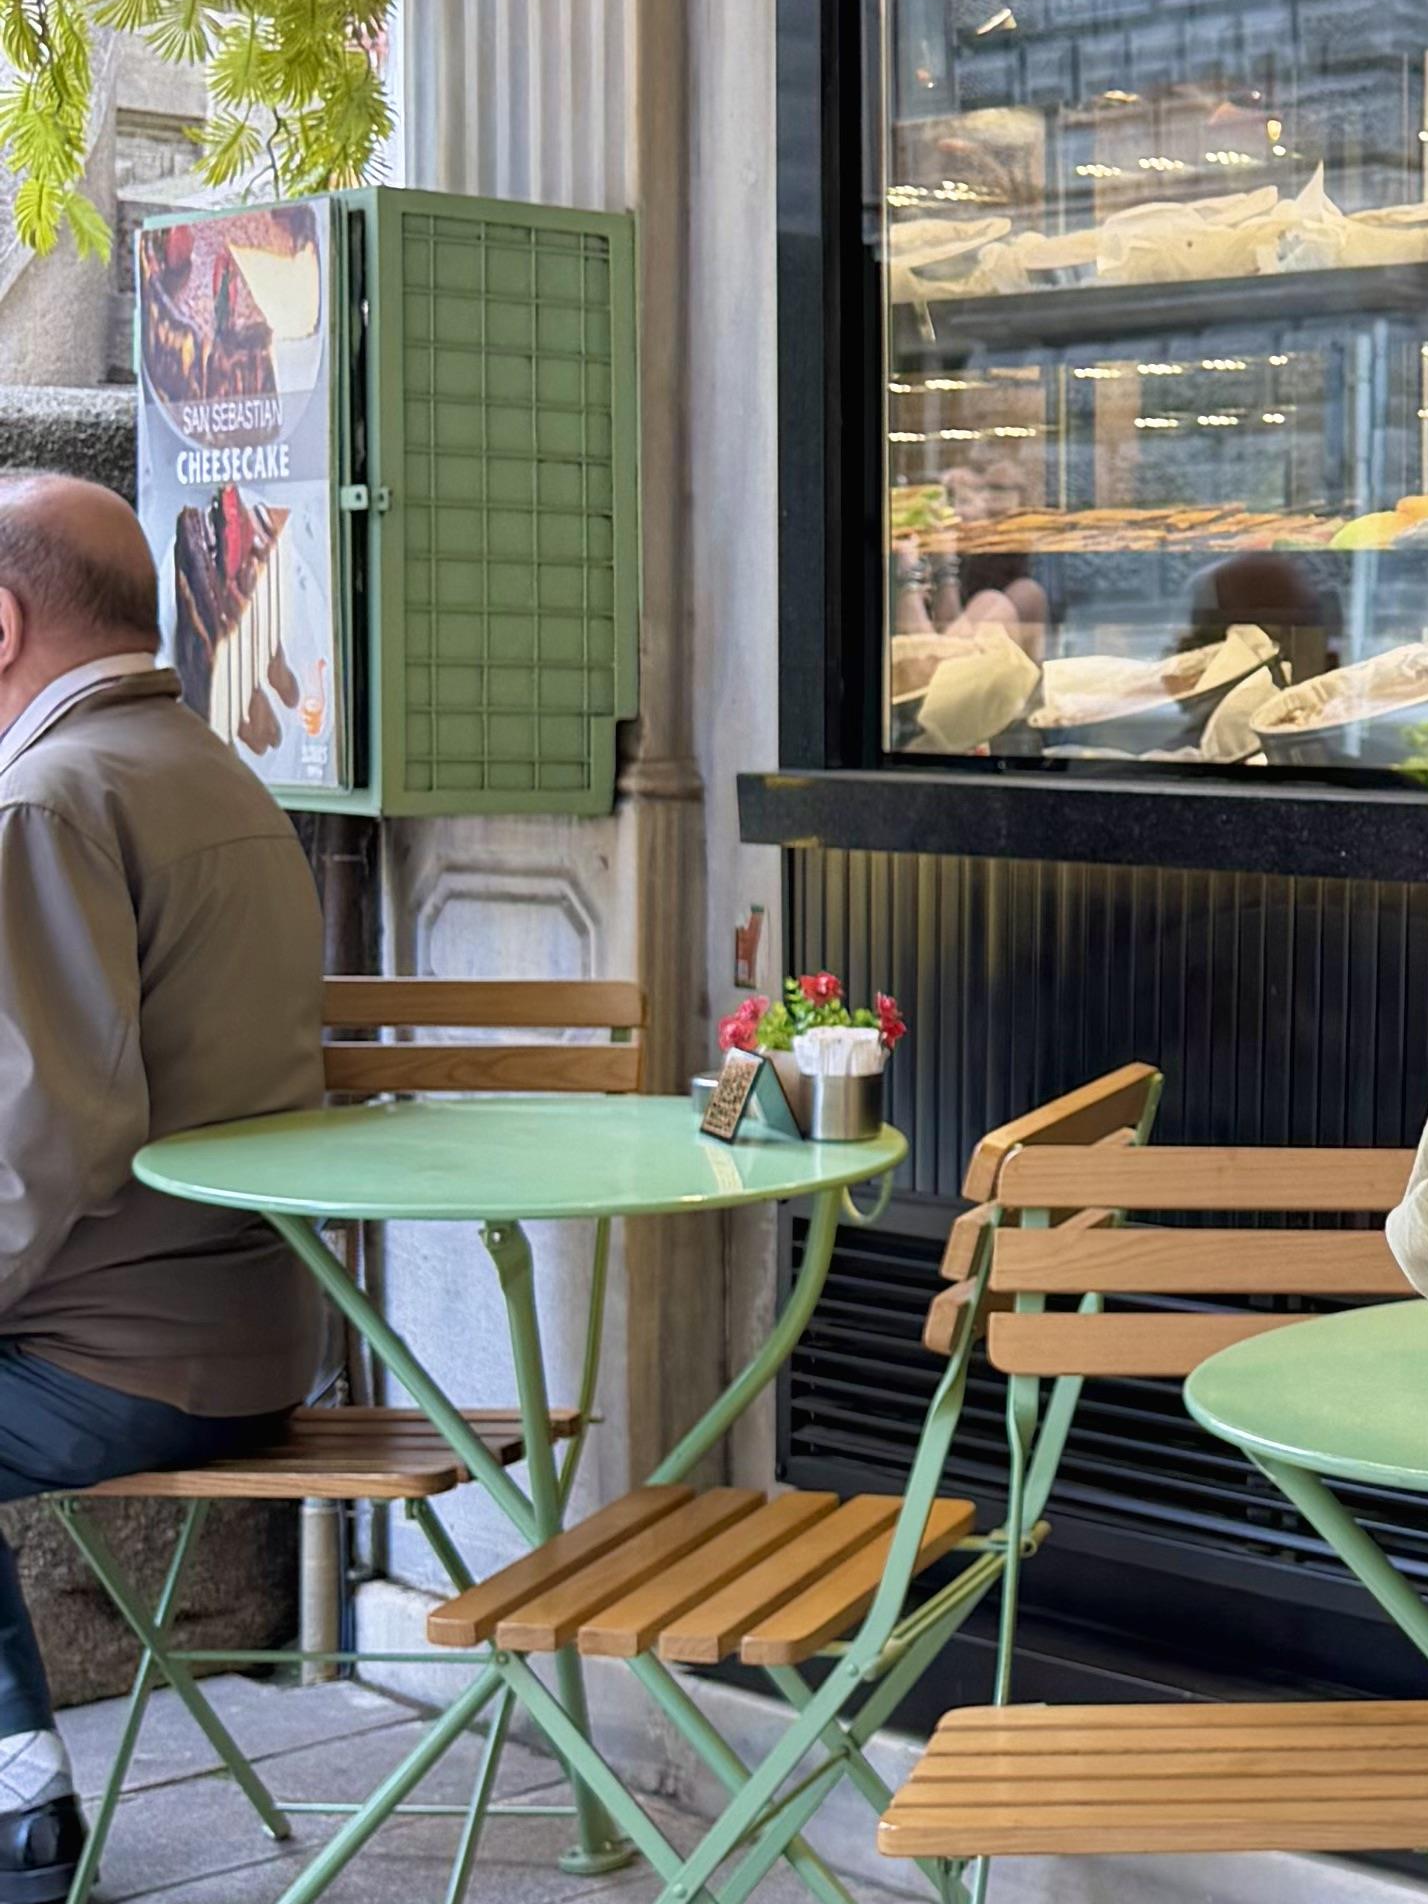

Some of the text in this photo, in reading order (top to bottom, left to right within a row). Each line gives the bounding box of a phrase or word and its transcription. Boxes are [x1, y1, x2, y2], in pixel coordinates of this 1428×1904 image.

[183, 399, 283, 435] SAN SEBASTIAN
[176, 443, 290, 485] CHEESECAKE
